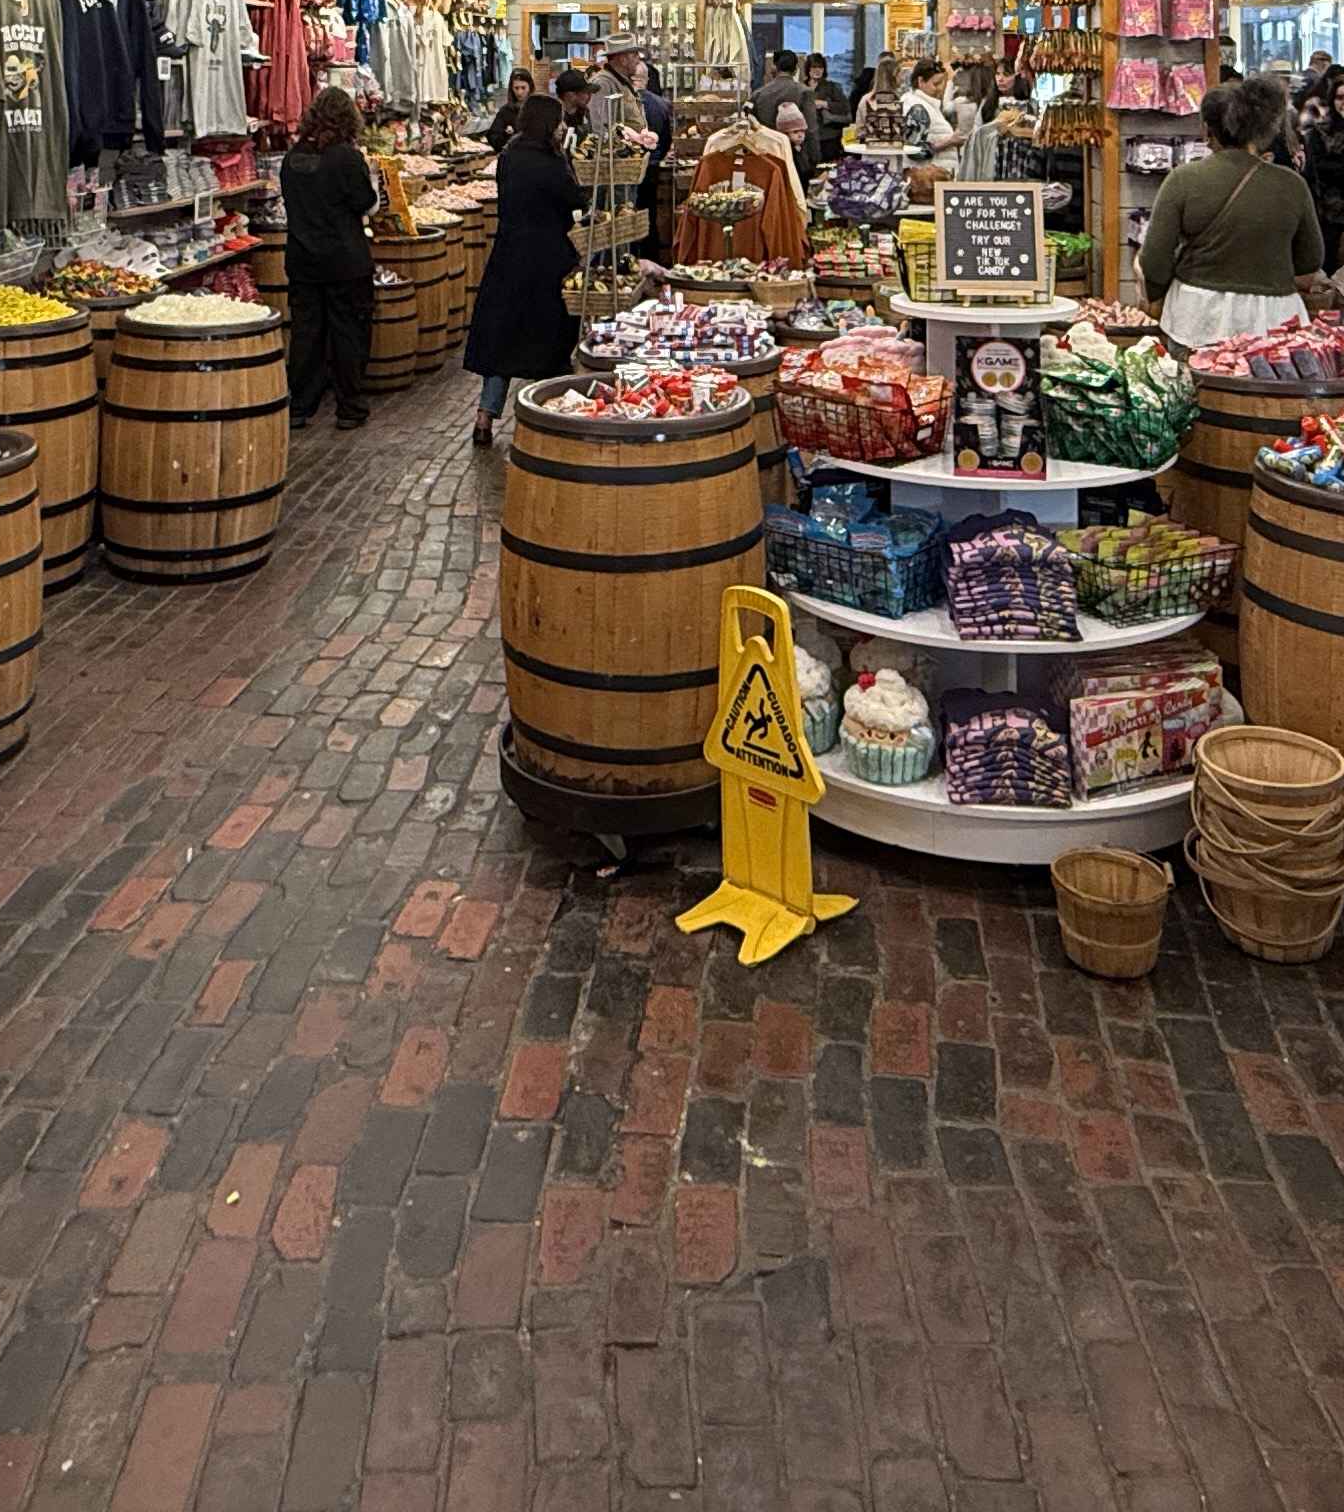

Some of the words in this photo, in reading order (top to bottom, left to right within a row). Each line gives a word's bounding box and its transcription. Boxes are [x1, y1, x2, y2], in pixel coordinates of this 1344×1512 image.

[964, 196, 983, 207] ARE
[990, 196, 1007, 207] YOU
[960, 209, 973, 218] UP
[977, 209, 996, 218] FOR
[1001, 209, 1018, 218] THE
[971, 235, 990, 245] TRY
[993, 236, 1011, 246] OUR
[981, 248, 1002, 257] NEW
[978, 266, 1005, 276] CANDY
[726, 680, 751, 730] CAUTION
[767, 690, 798, 754] CUIDADO
[736, 746, 789, 778] ATTENTION
